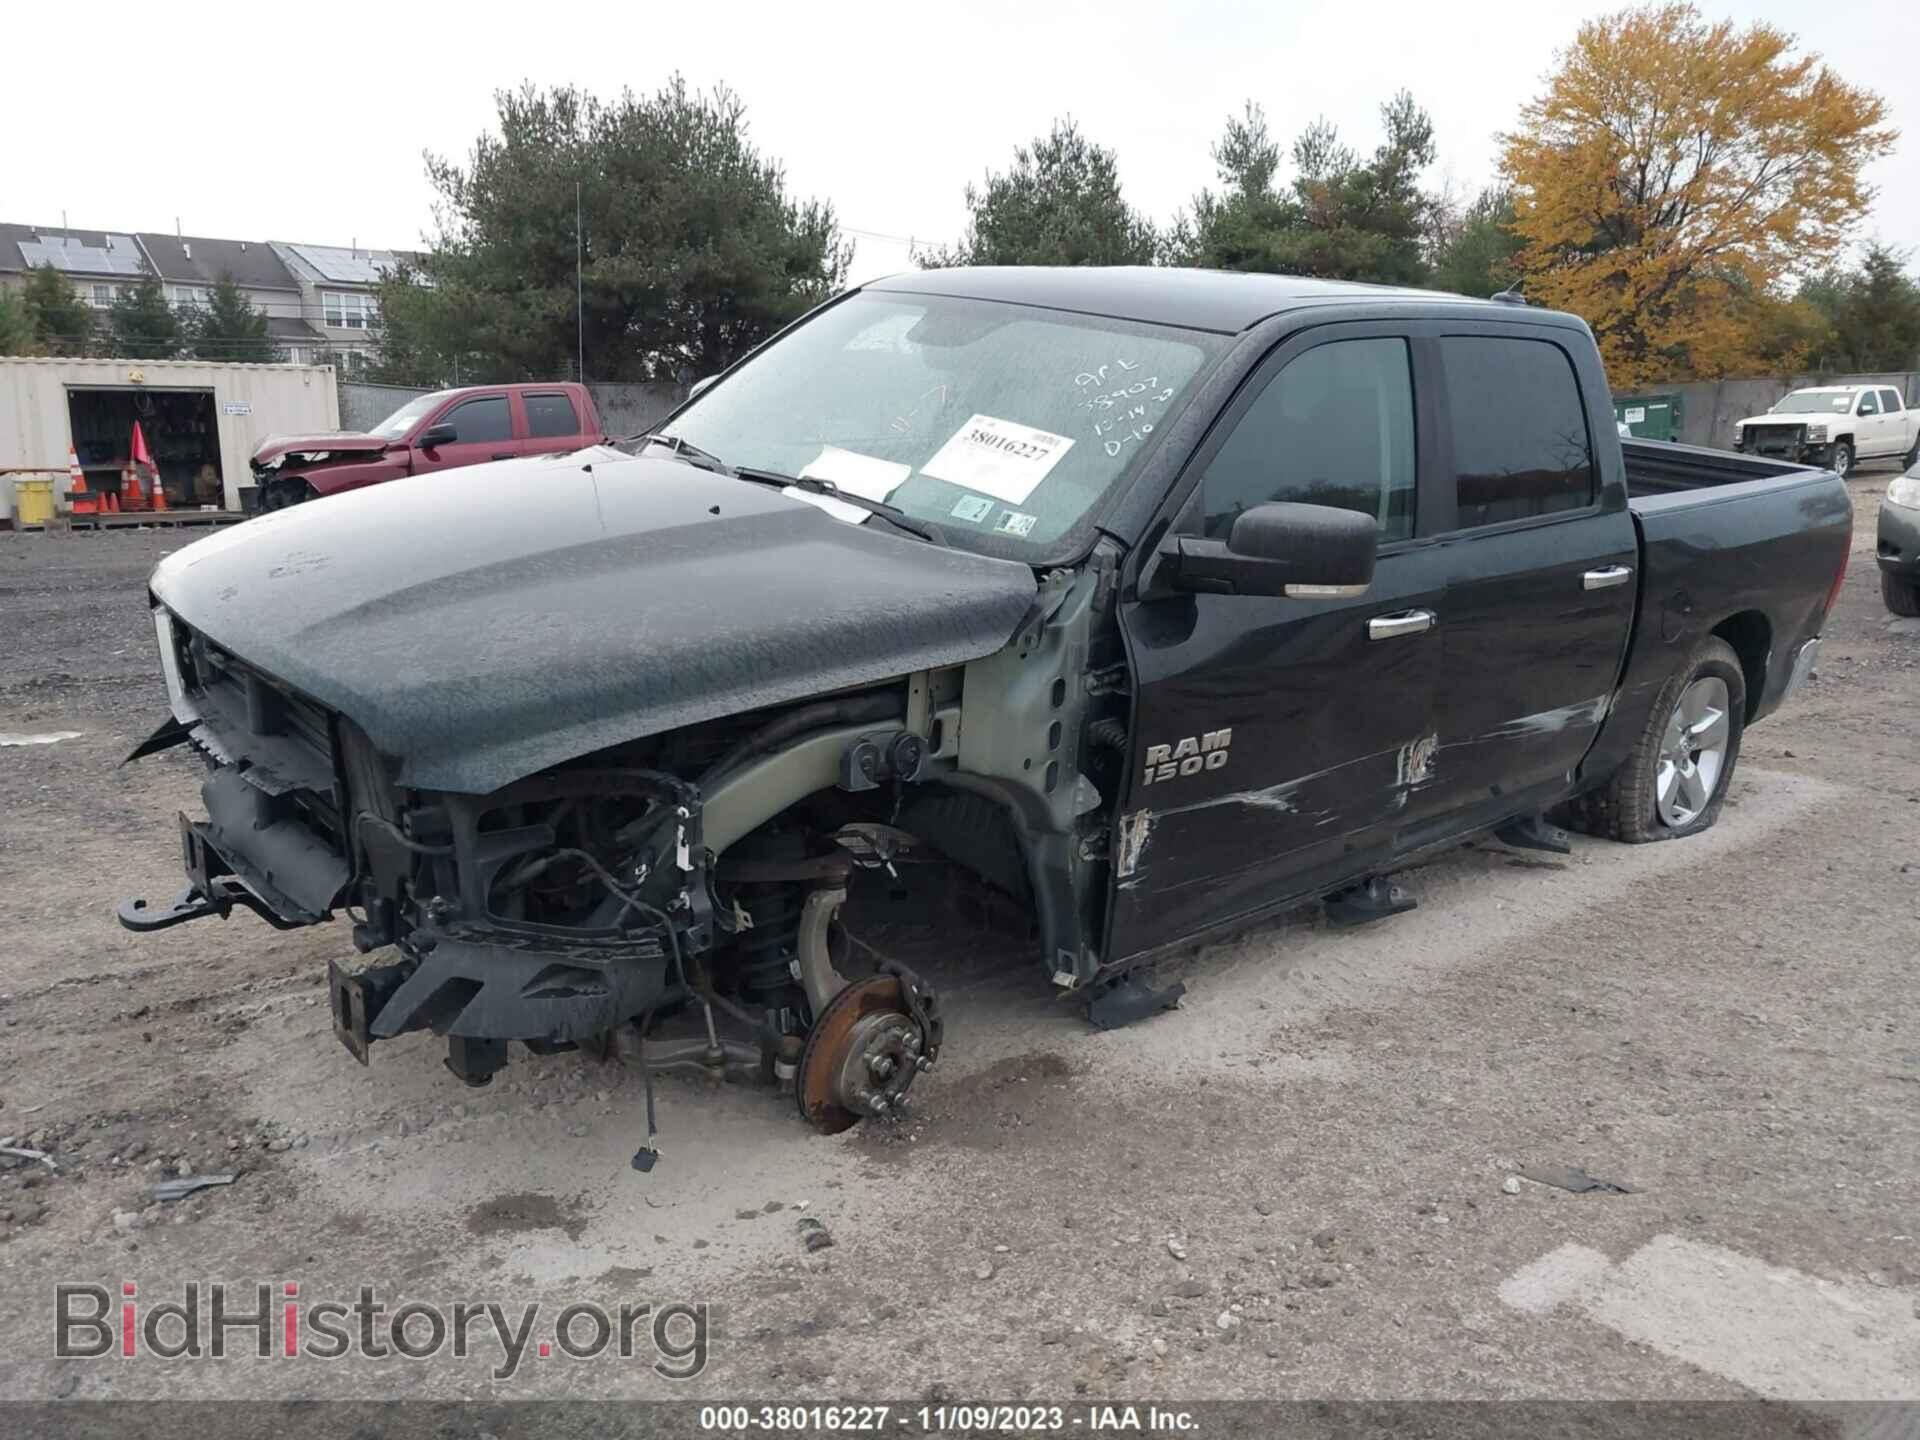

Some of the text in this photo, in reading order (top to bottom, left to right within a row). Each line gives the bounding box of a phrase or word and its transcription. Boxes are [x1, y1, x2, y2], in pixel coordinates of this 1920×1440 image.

[970, 428, 1049, 461] 38016227
[1145, 728, 1232, 766] RAM
[1143, 750, 1228, 786] 1500
